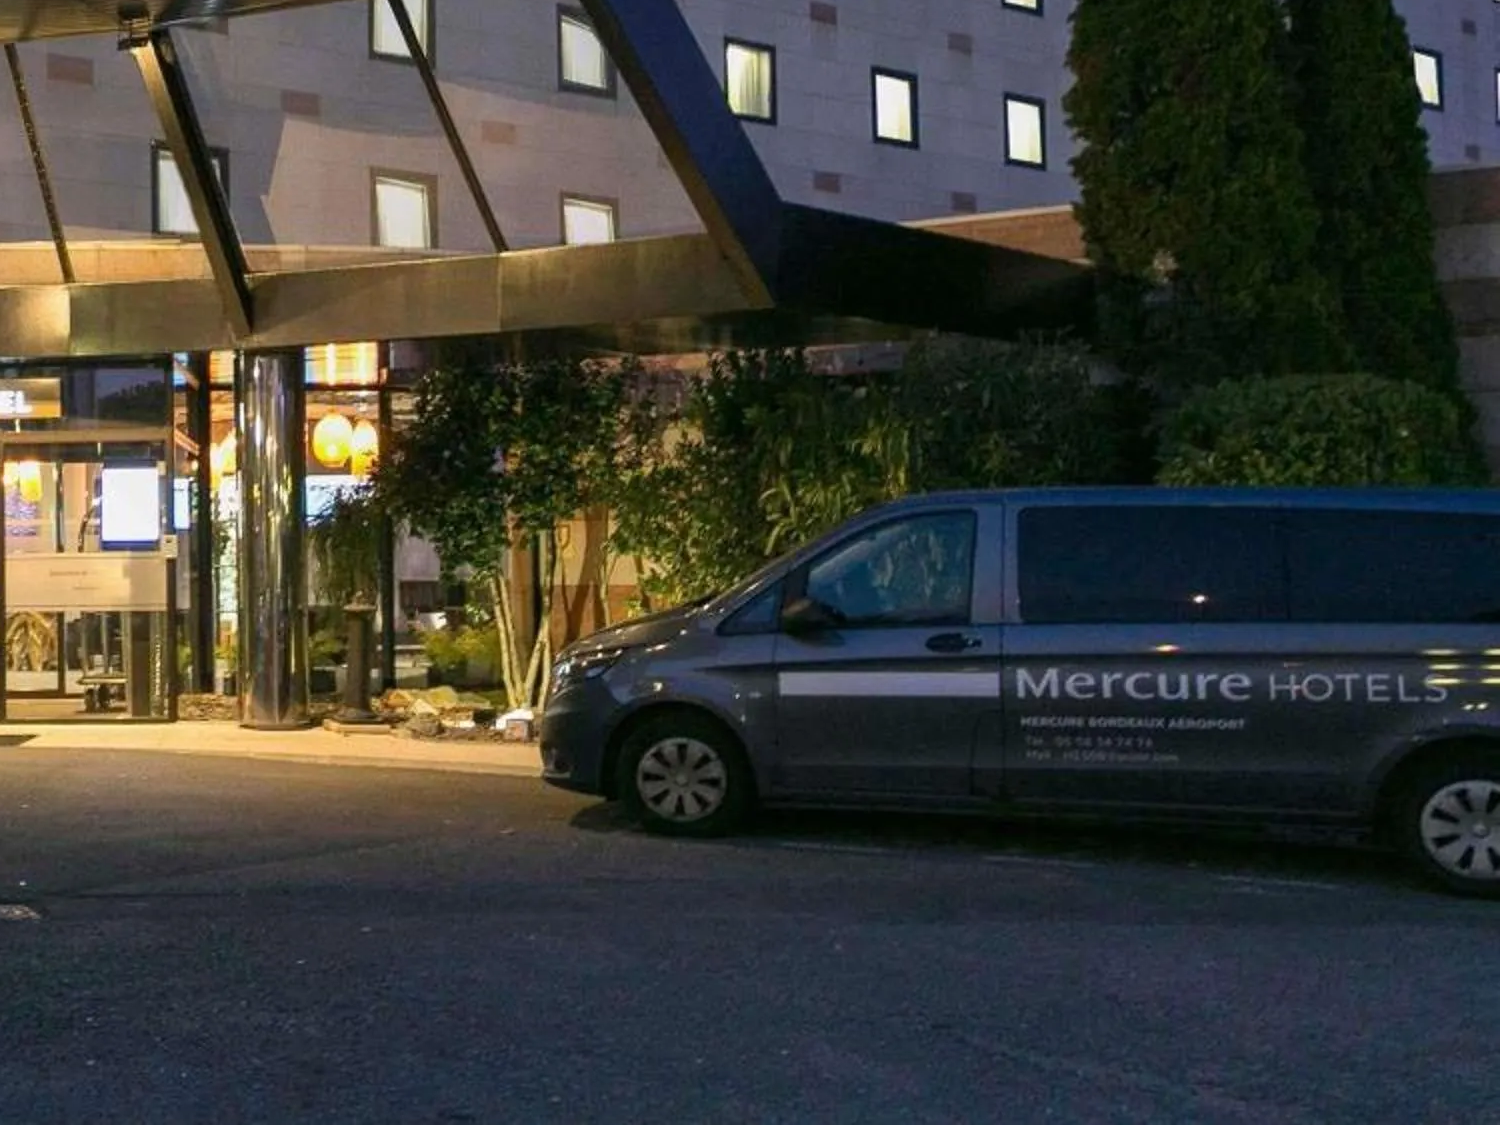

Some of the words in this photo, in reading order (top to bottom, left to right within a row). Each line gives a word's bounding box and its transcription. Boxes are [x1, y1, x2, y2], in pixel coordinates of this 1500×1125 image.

[1015, 668, 1251, 701] Mercure
[1269, 673, 1449, 703] HOTELS
[1019, 716, 1084, 728] MERCURE
[1088, 716, 1164, 729] BORDEAUX
